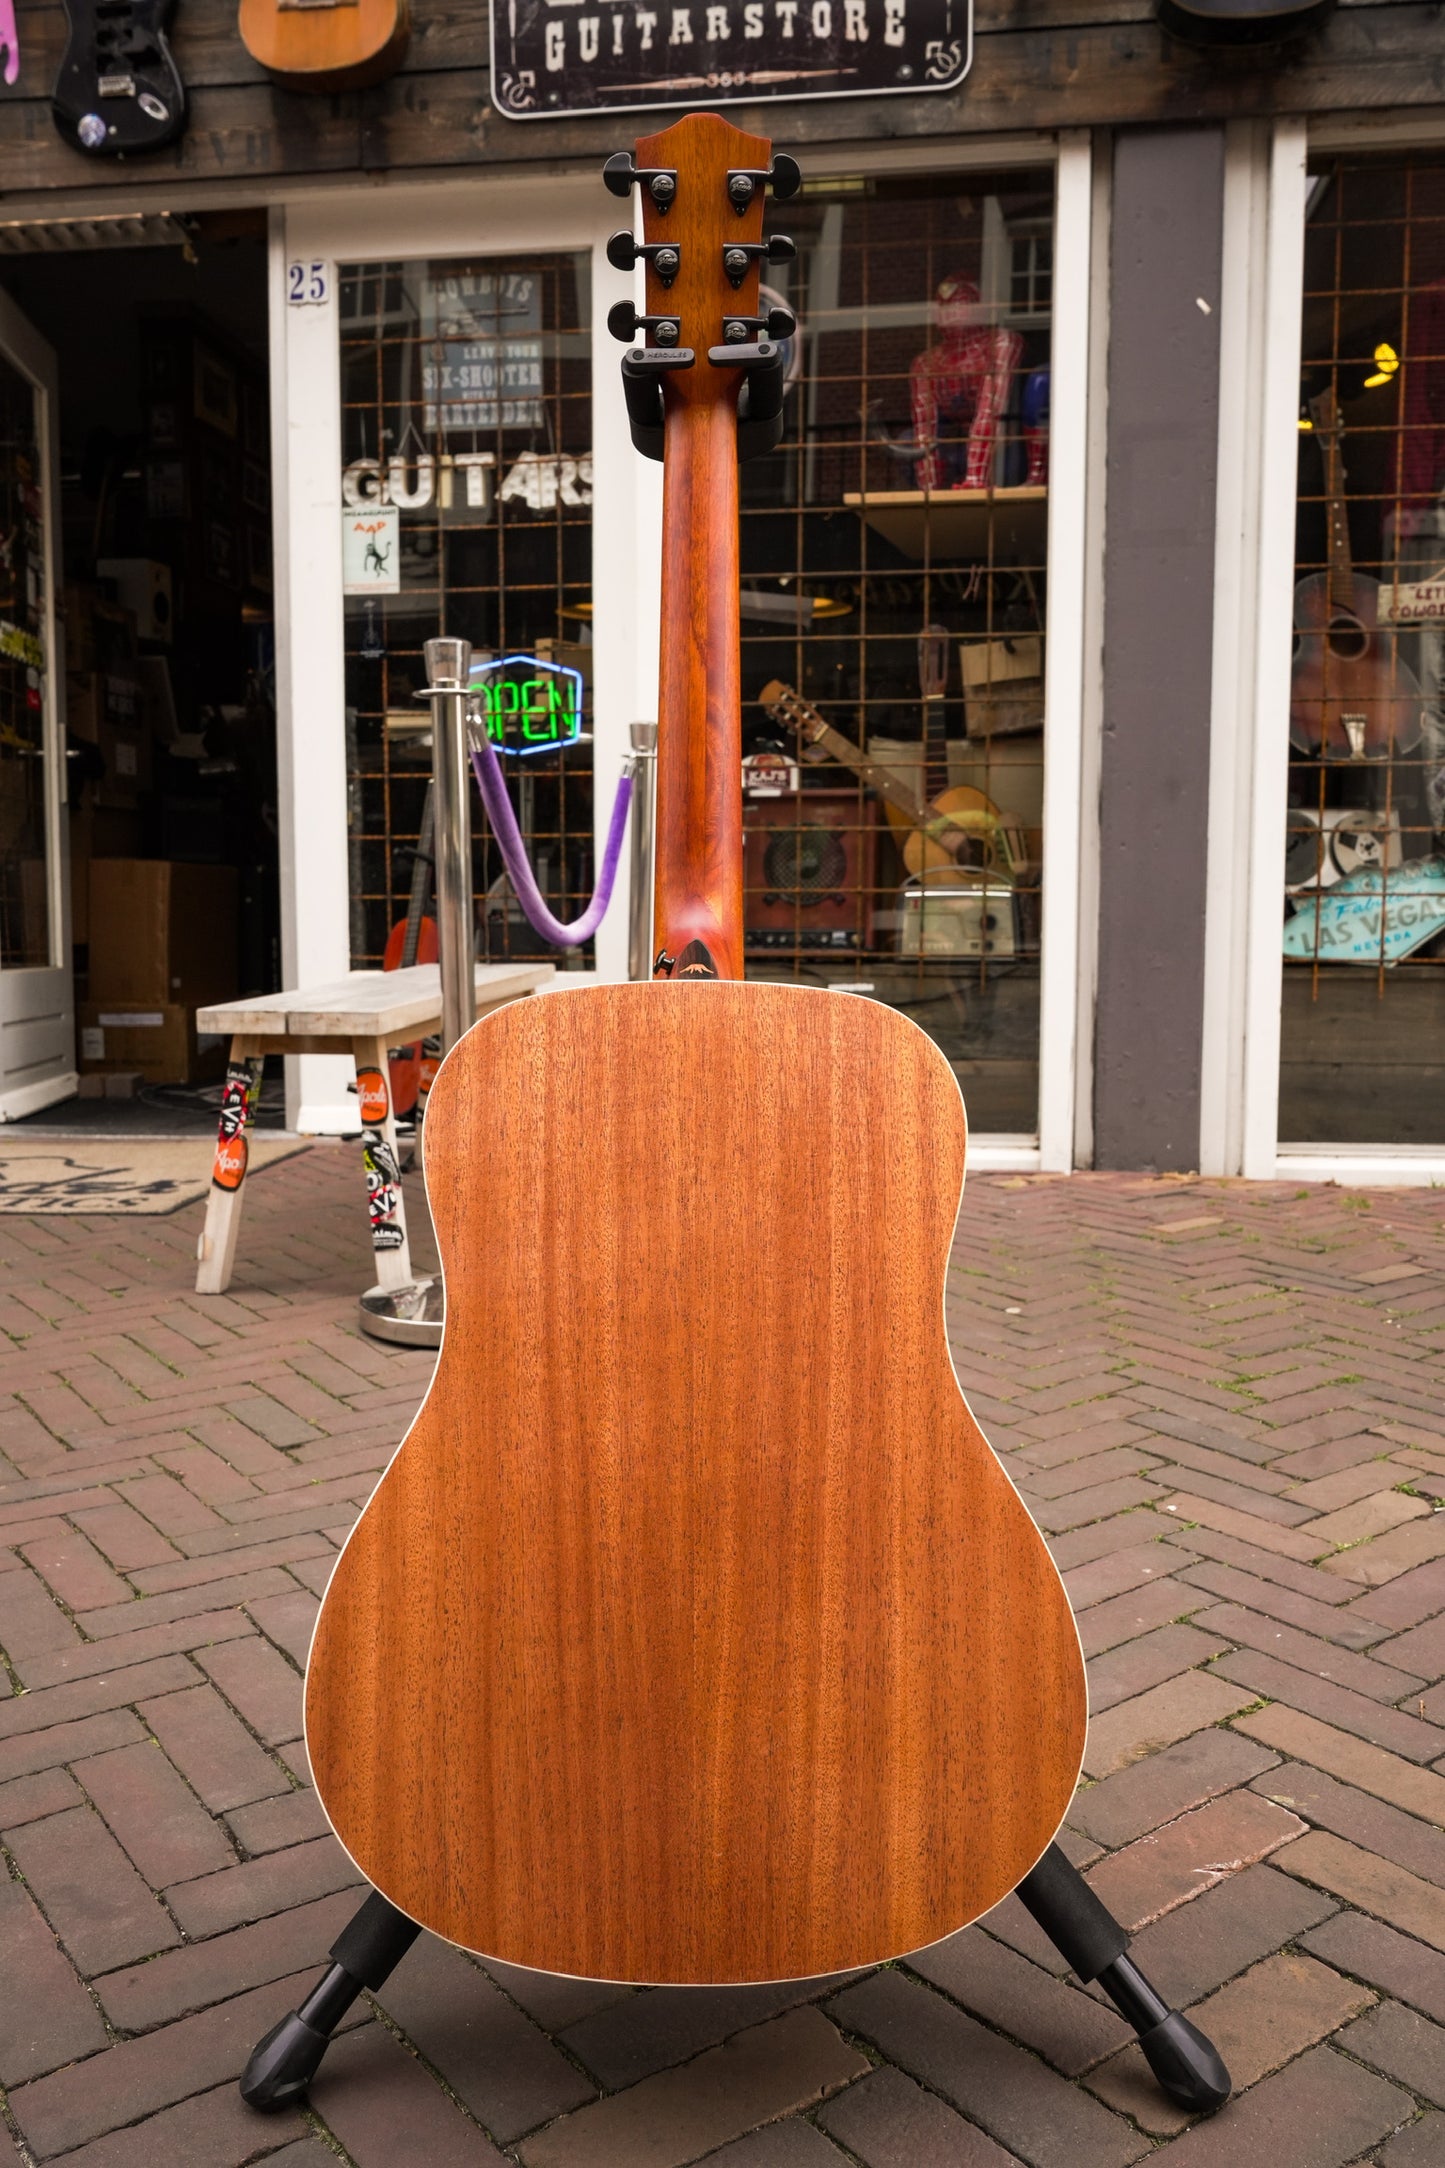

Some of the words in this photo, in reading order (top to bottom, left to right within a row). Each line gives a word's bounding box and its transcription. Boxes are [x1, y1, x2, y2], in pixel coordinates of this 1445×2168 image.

[544, 0, 906, 72] GUITARSTORE
[289, 264, 326, 301] 25
[1301, 920, 1353, 953] LAS
